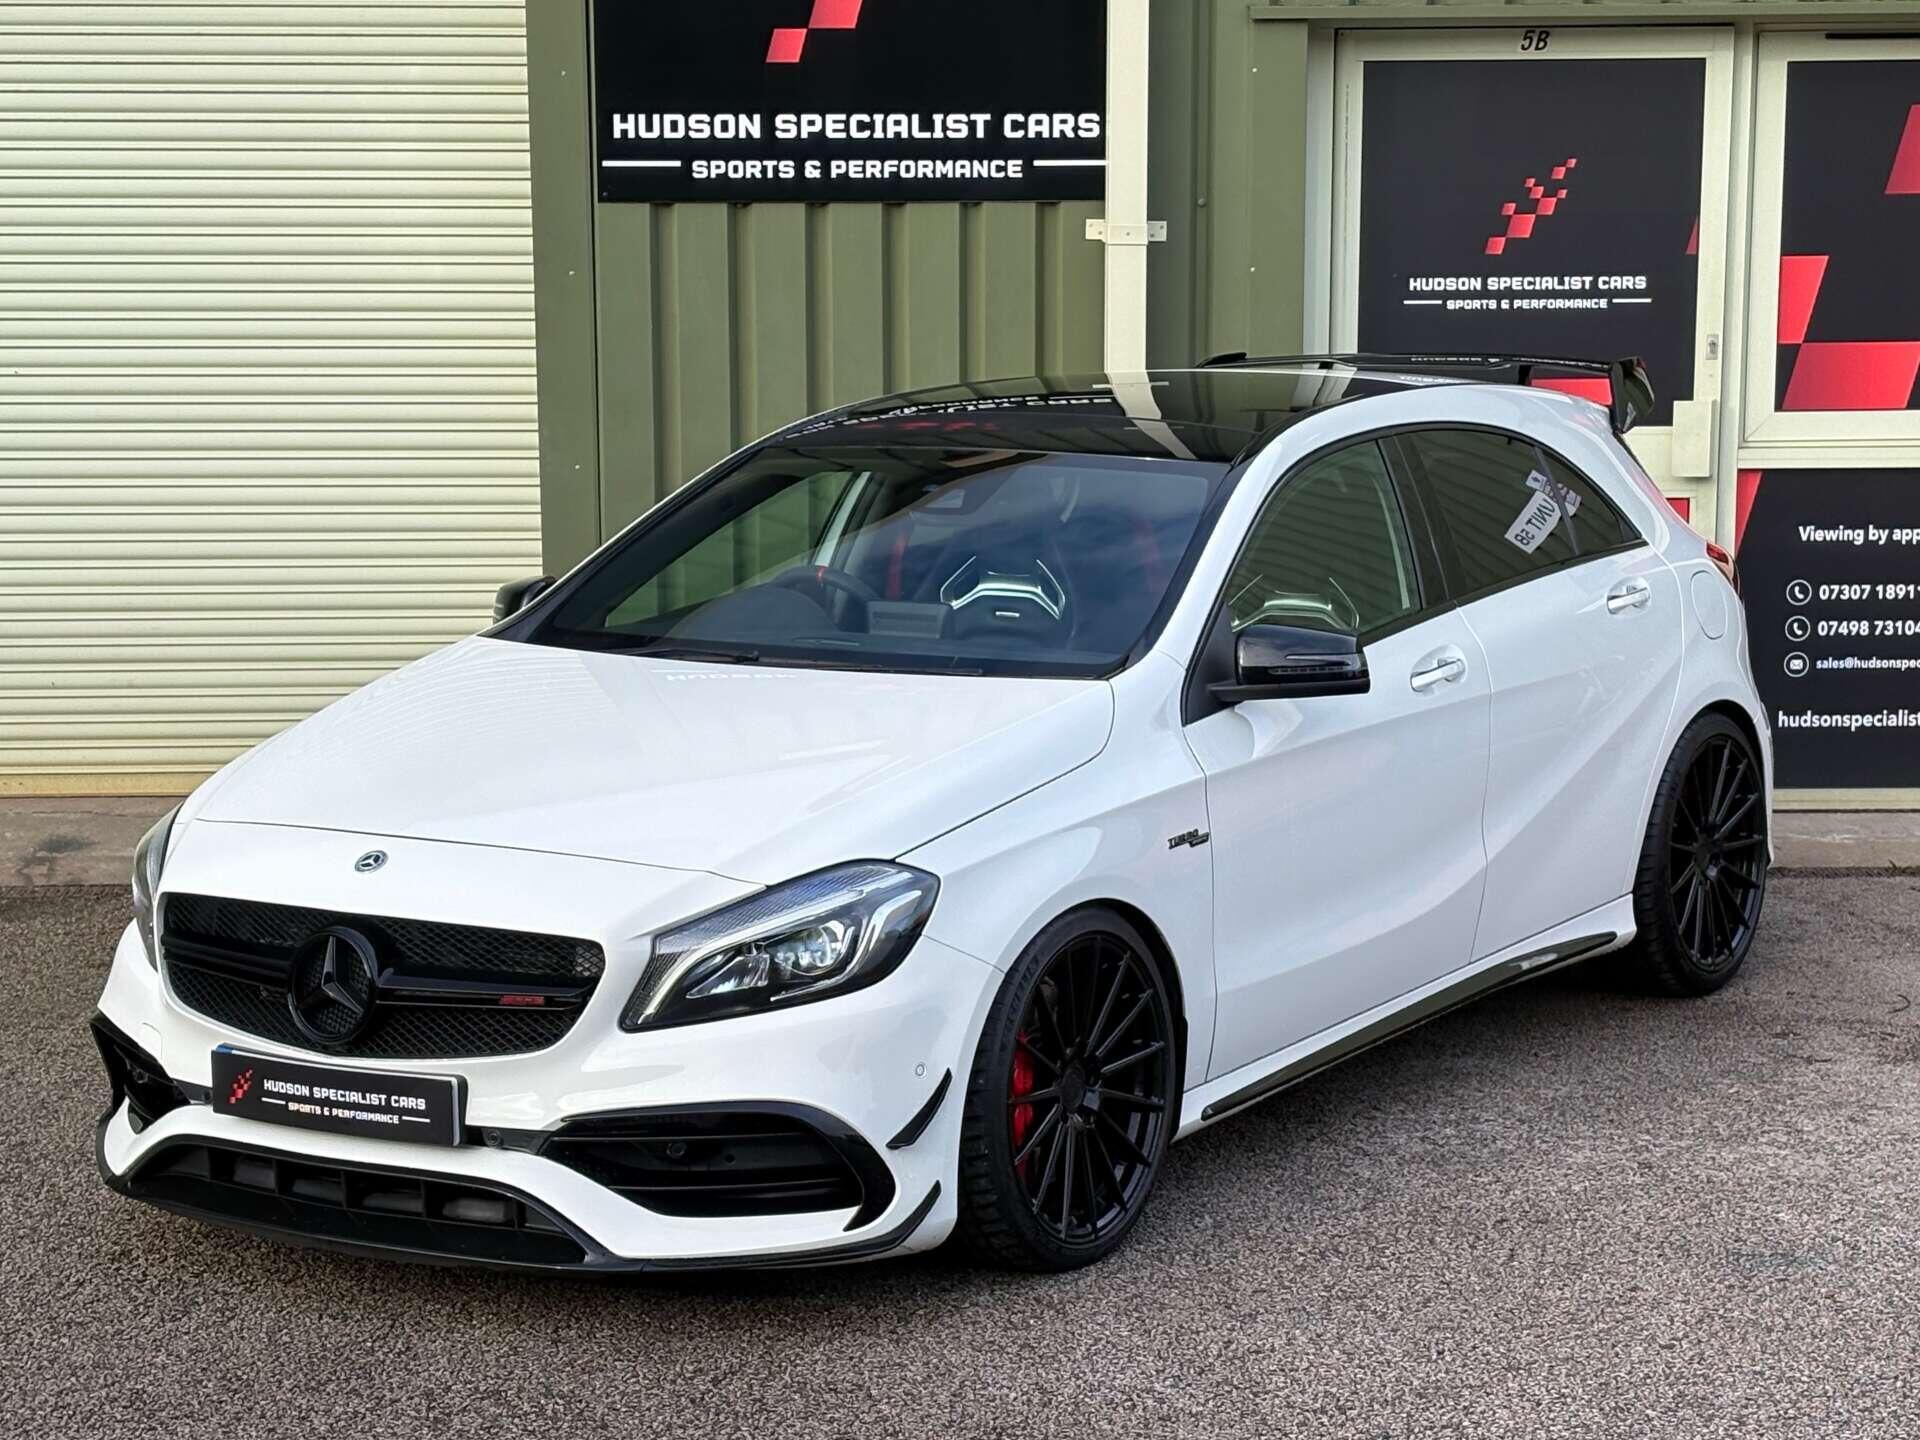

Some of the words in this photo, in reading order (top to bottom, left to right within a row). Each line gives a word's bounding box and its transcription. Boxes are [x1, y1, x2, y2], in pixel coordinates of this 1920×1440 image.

[1520, 29, 1551, 51] 5B
[612, 112, 761, 139] HUDSON
[774, 112, 992, 139] SPECIALIST
[1003, 112, 1101, 139] CARS
[691, 159, 796, 179] SPORTS
[804, 159, 822, 178] &
[830, 159, 1024, 179] PERFORMANCE
[1408, 276, 1482, 291] HUDSON
[1486, 276, 1594, 291] SPECIALIST
[1597, 275, 1647, 290] CARS
[1446, 299, 1498, 310] SPORTS
[1512, 298, 1609, 310] PERFORMANCE
[1798, 524, 1865, 546] Viewing
[1868, 524, 1890, 546] by
[1892, 528, 1920, 546] app
[1818, 584, 1872, 601] 07307
[1817, 620, 1870, 637] 07498
[263, 1079, 310, 1097] HUDSON
[312, 1086, 388, 1107] SPECIALIST
[391, 1095, 426, 1110] CARS
[287, 1102, 322, 1115] SPORTS
[332, 1108, 400, 1125] PERFORMANCE
